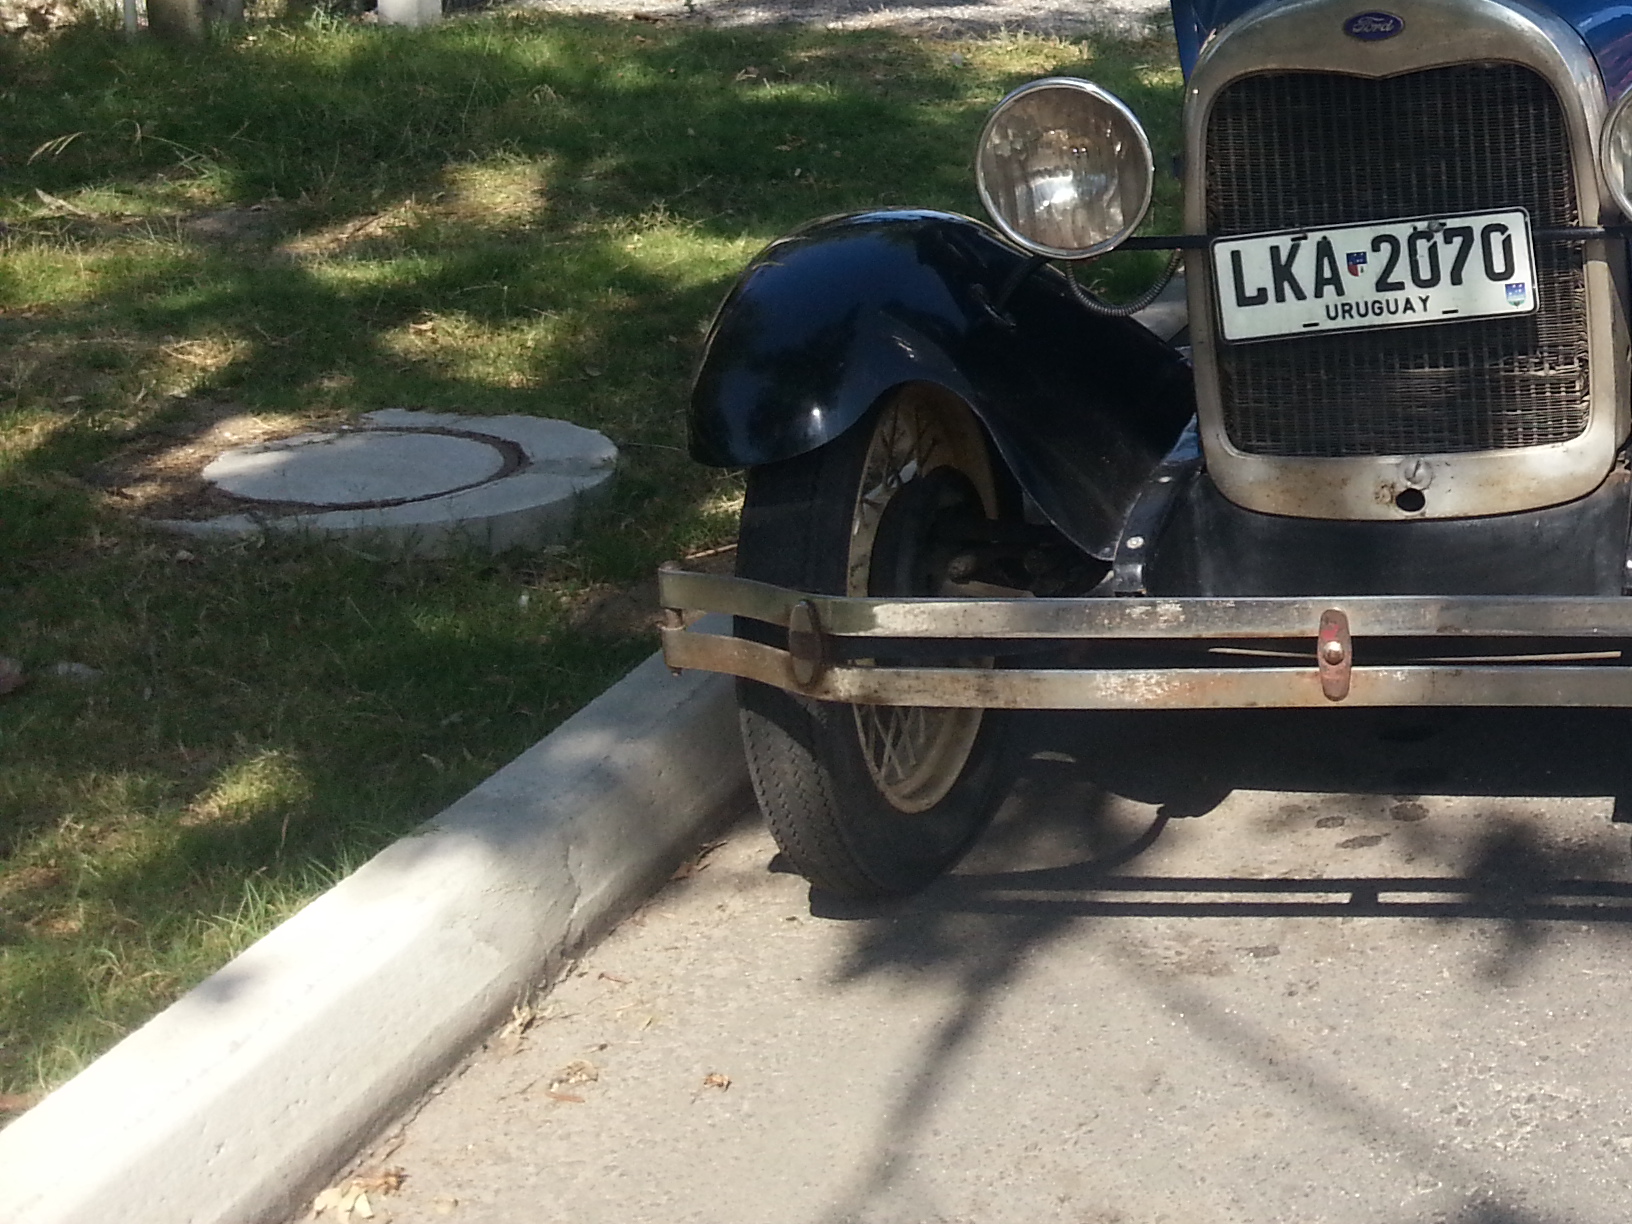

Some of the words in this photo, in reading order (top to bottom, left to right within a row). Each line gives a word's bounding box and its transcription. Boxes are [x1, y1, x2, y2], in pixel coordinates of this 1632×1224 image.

[1352, 15, 1395, 34] Ford
[1230, 234, 1345, 308] LKA
[1370, 222, 1516, 293] 2070
[1325, 294, 1432, 322] URUGUAY
